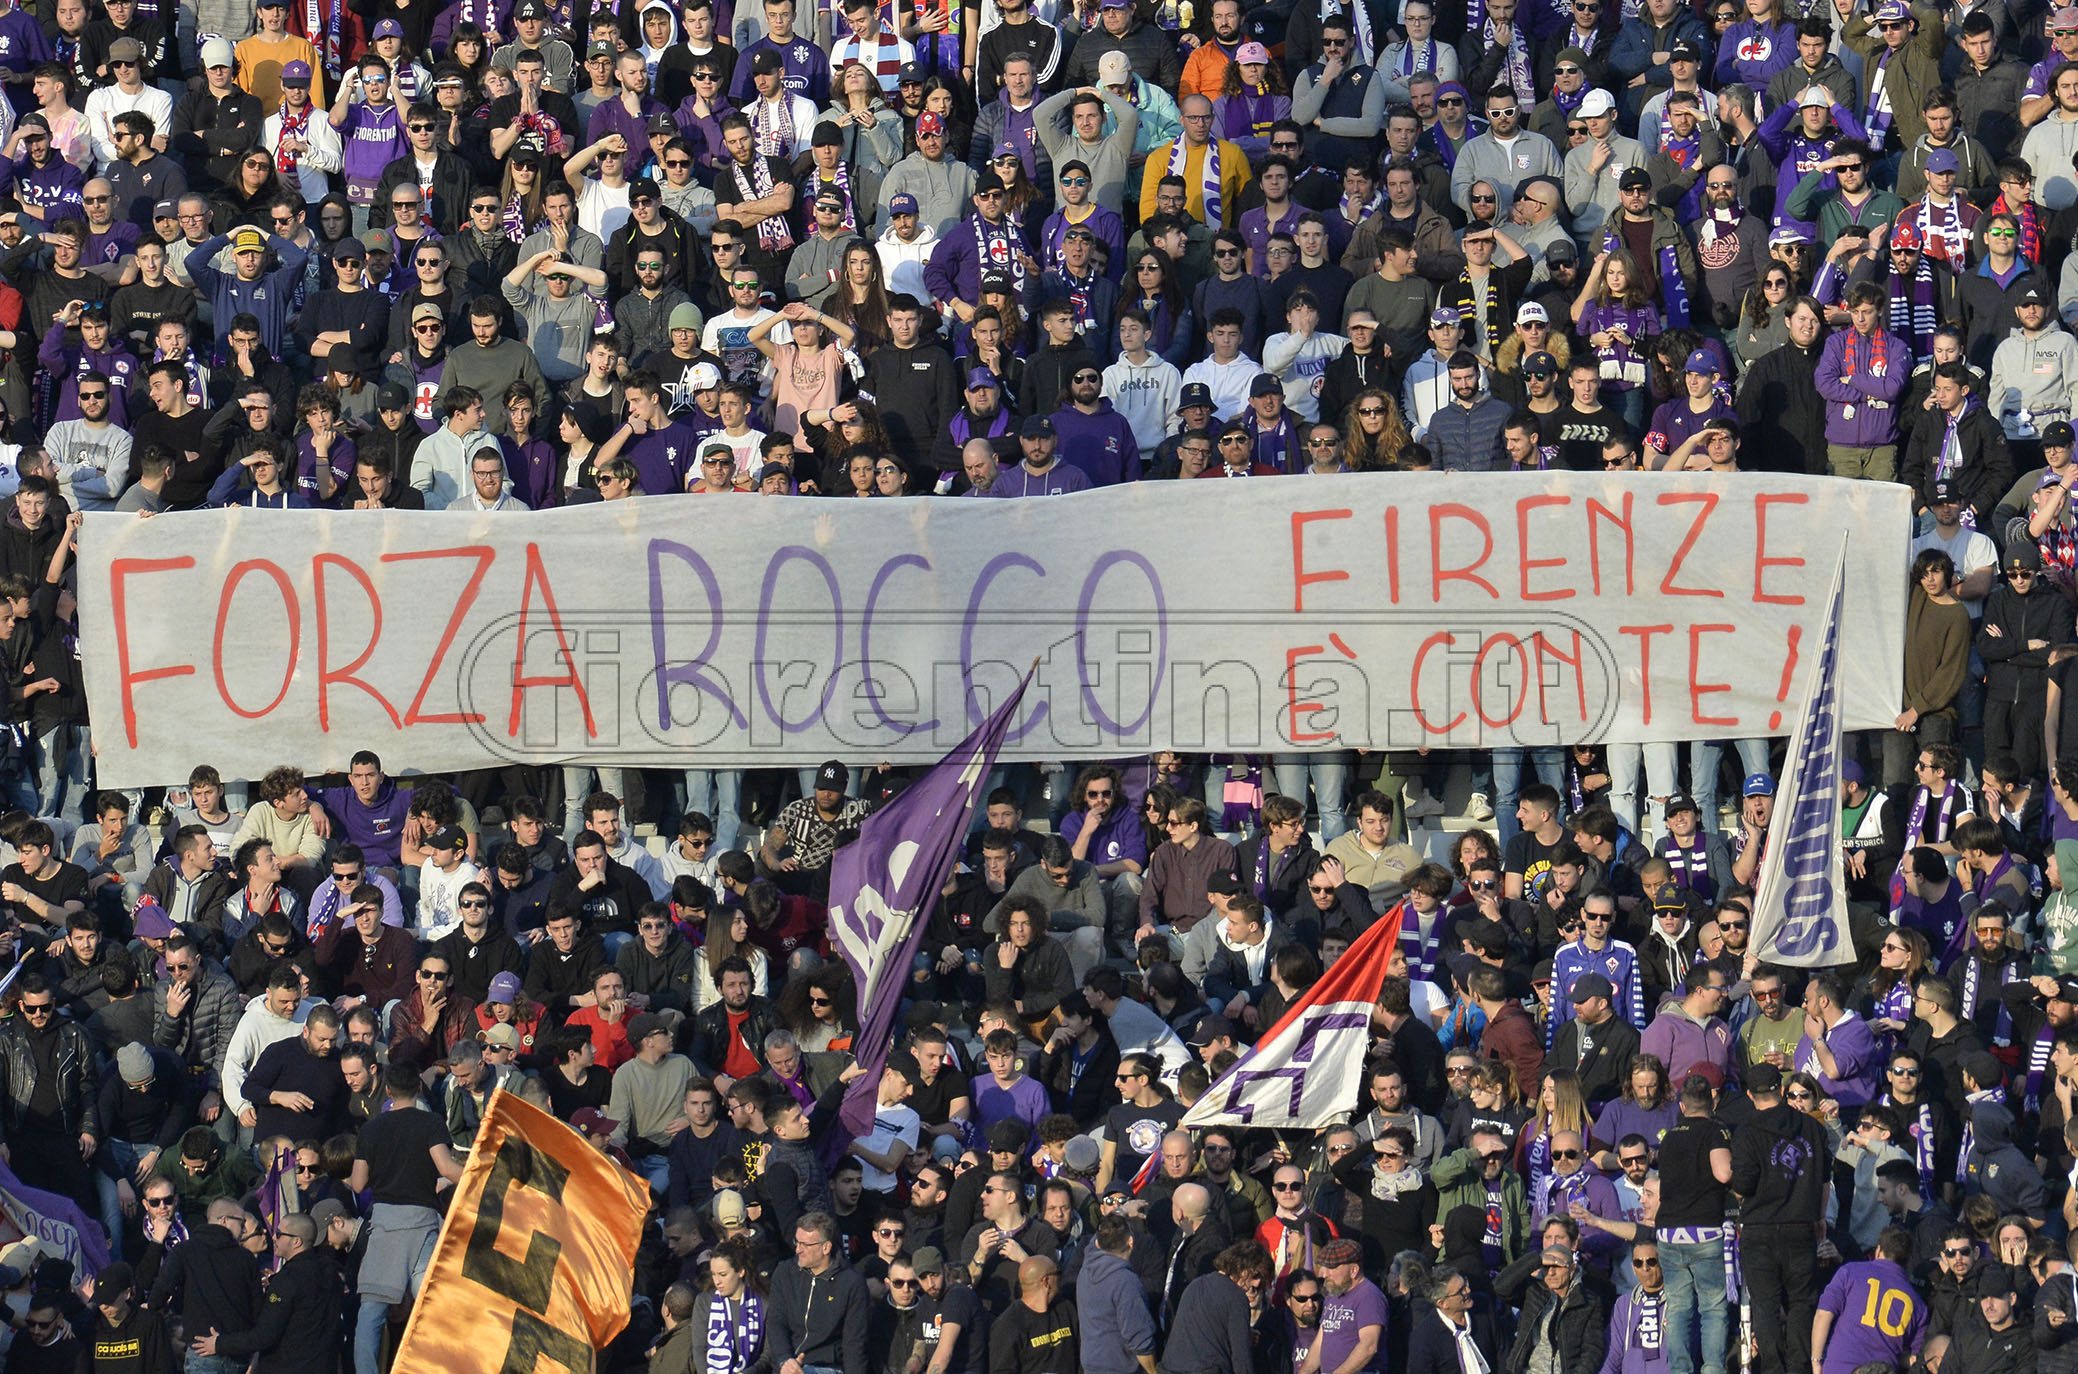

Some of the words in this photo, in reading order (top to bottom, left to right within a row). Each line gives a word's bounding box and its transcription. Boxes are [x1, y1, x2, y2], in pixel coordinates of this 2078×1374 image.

[1120, 378, 1160, 393] datch
[2036, 351, 2058, 359] NASA
[1560, 424, 1610, 442] GUESS
[1291, 491, 1809, 613] FIRENZE
[110, 542, 598, 749] FORZA
[649, 540, 1167, 737] ROCCO
[1286, 632, 1357, 742] È
[1861, 1277, 1915, 1338] 10
